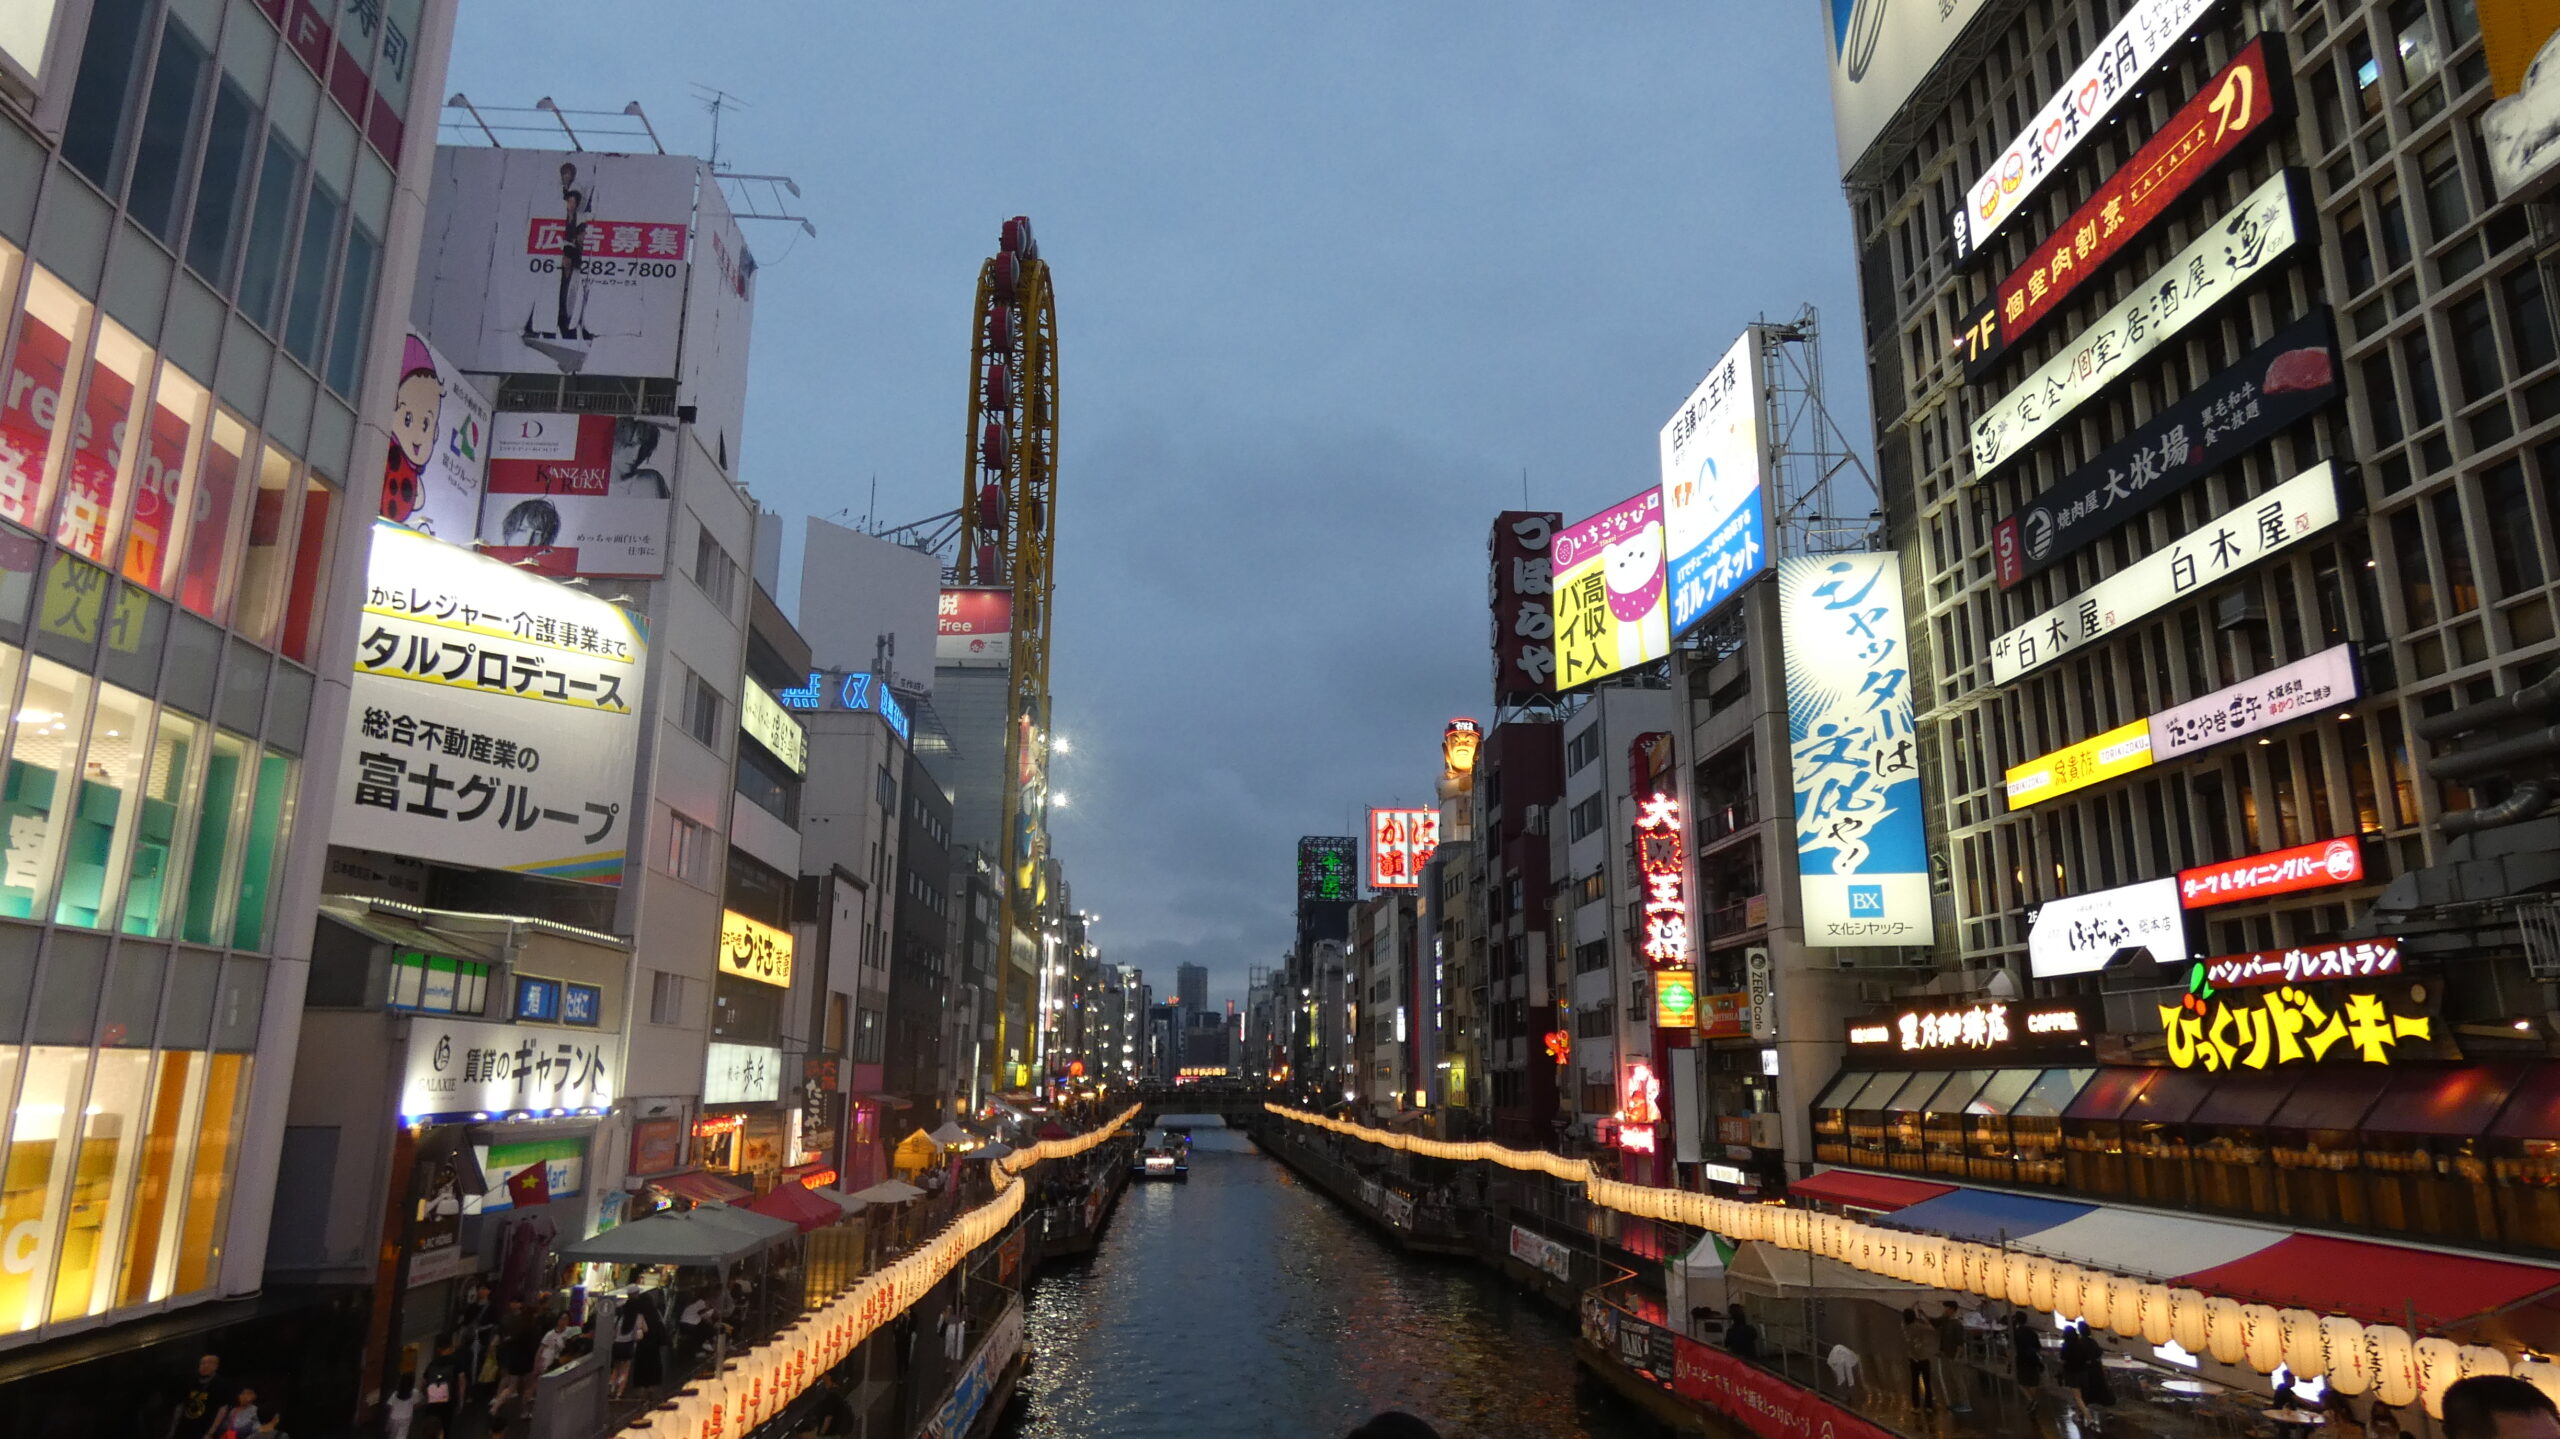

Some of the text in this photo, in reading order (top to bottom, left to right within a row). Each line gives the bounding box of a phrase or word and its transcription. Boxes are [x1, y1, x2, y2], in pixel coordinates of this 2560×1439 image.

[2005, 65, 2252, 324] 個室肉割烹 KATANA 刀
[1953, 211, 1966, 258] 8F
[529, 258, 676, 279] 06-282-7800
[1965, 310, 1996, 362] 7F
[2017, 254, 2215, 431] 完全個室居酒屋
[536, 464, 606, 483] KANZAKI
[560, 477, 603, 493] RUKA
[2056, 424, 2191, 531] 焼肉屋 大牧場
[1573, 503, 1646, 550] いちごなび
[1999, 526, 2013, 580] 5F
[1674, 531, 1760, 626] ガルフネット
[1995, 501, 2291, 670] 4F 白木屋 白木屋
[939, 619, 973, 632] Free
[1559, 579, 1583, 682] バイト
[1582, 571, 1608, 675] 高収入
[362, 627, 625, 710] タルプロデュース
[361, 706, 540, 773] 総合不動産業の
[355, 752, 620, 845] 富士グループ
[1380, 818, 1440, 846] かに
[1852, 893, 1881, 910] BX
[2027, 911, 2039, 924] 2F
[2208, 944, 2398, 984] ハンバーグレストラン
[2028, 1011, 2079, 1033] COFFEE
[2158, 986, 2431, 1072] びっくりドンキー
[463, 1038, 607, 1095] 賃貸のギャラント
